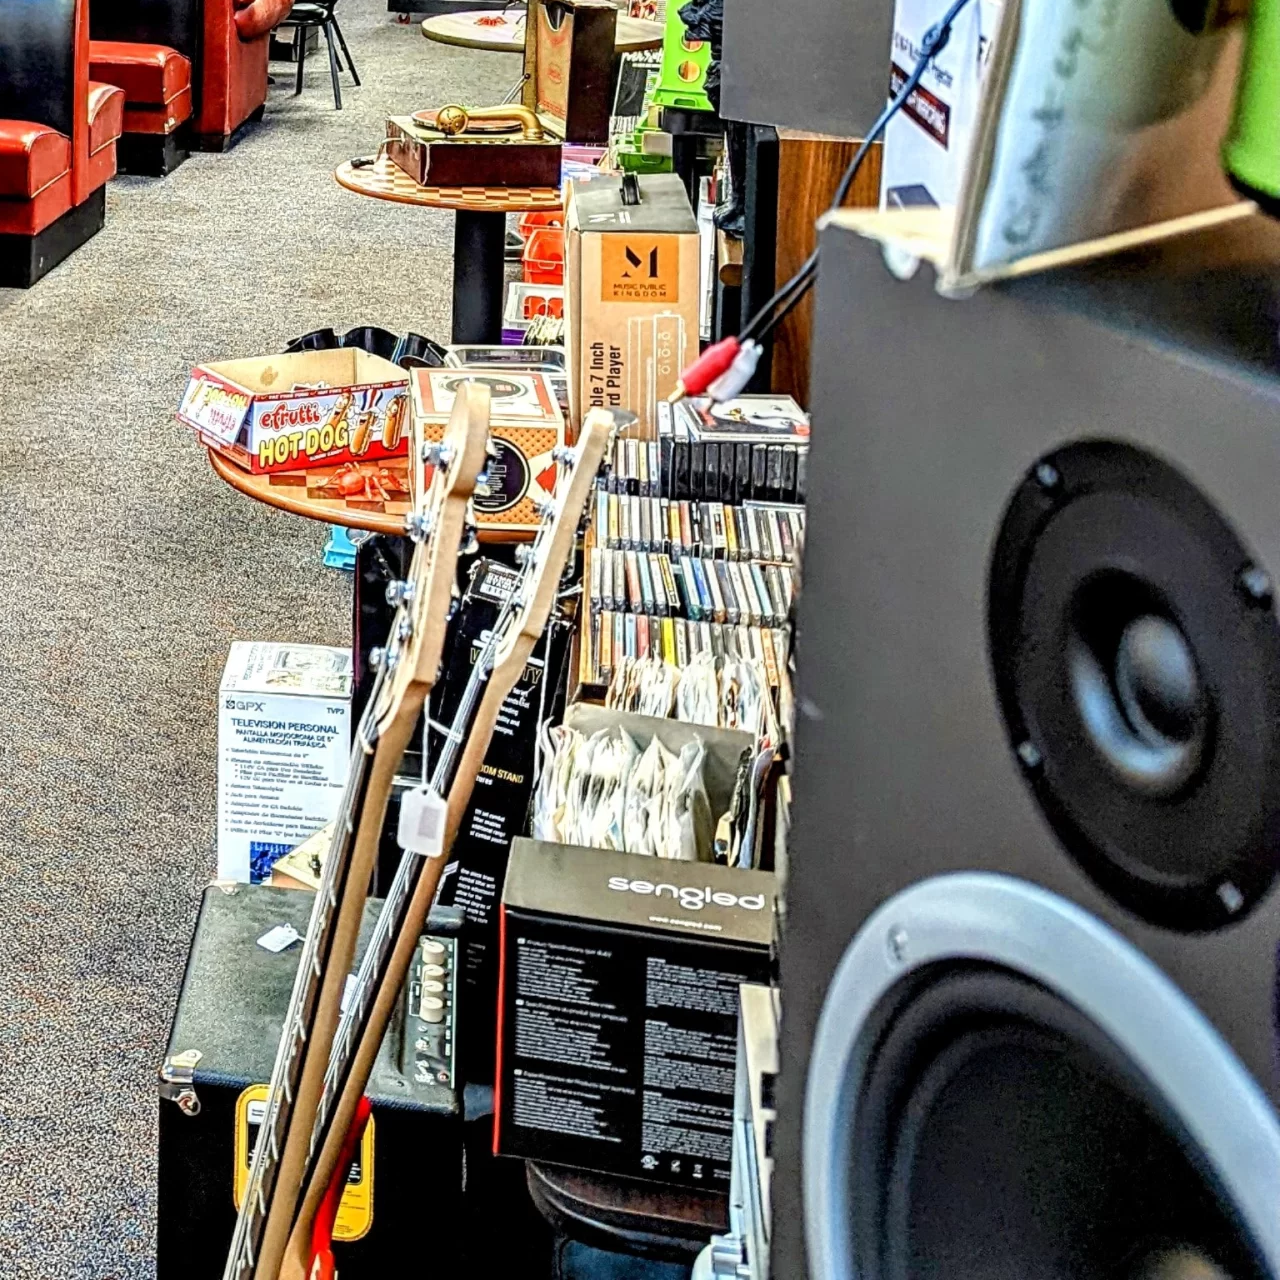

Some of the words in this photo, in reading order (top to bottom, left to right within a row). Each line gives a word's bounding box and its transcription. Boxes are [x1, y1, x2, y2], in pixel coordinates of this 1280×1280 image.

[589, 342, 604, 370] Inch
[607, 346, 624, 387] Player
[590, 375, 604, 383] 7
[589, 386, 604, 407] ble
[259, 401, 321, 431] efrutti
[259, 431, 303, 468] HOT
[305, 420, 349, 456] DOG
[236, 702, 263, 712] GPX
[231, 718, 286, 730] TELEVISION
[288, 722, 339, 734] PERSONAL
[236, 728, 269, 737] PANTALLA
[270, 731, 314, 740] MONOCROMA
[497, 767, 524, 783] STAND
[608, 876, 765, 910] sengled
